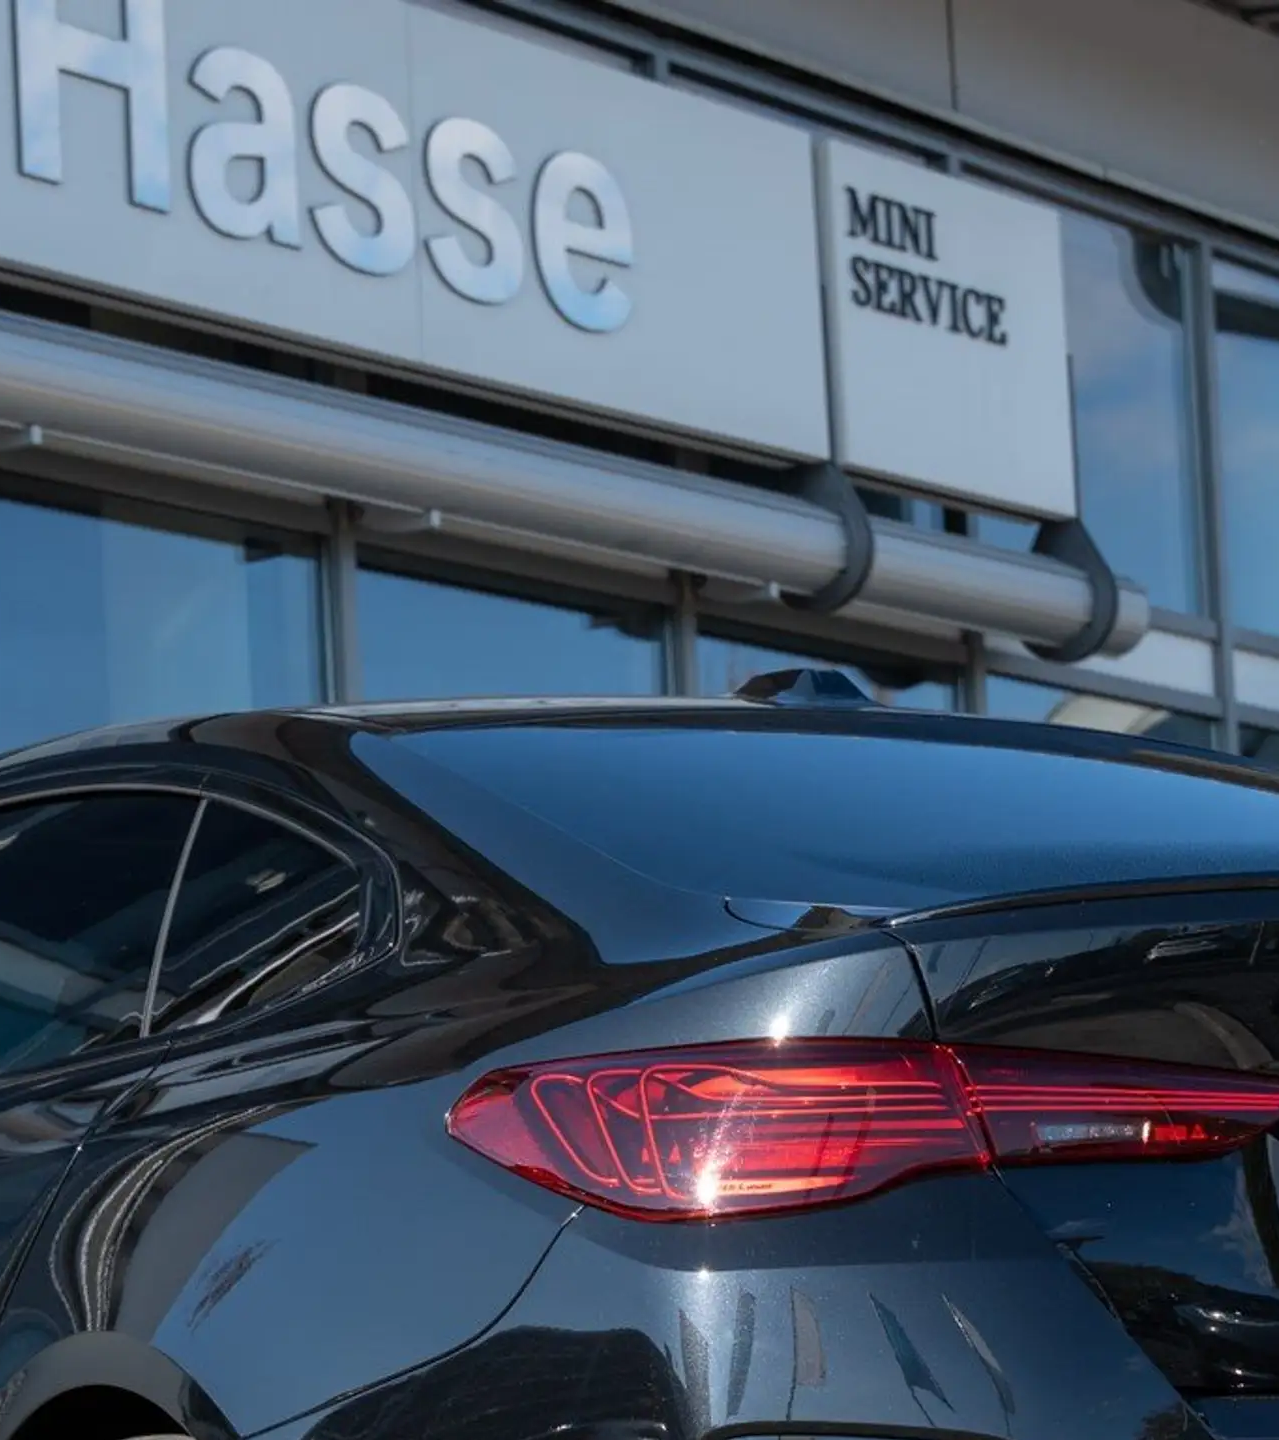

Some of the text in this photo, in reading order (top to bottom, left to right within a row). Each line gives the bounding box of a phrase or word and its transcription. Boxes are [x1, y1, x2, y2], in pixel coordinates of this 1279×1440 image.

[11, 0, 635, 334] Hasse
[844, 186, 938, 261] MINI
[849, 257, 1008, 346] SERVICE
